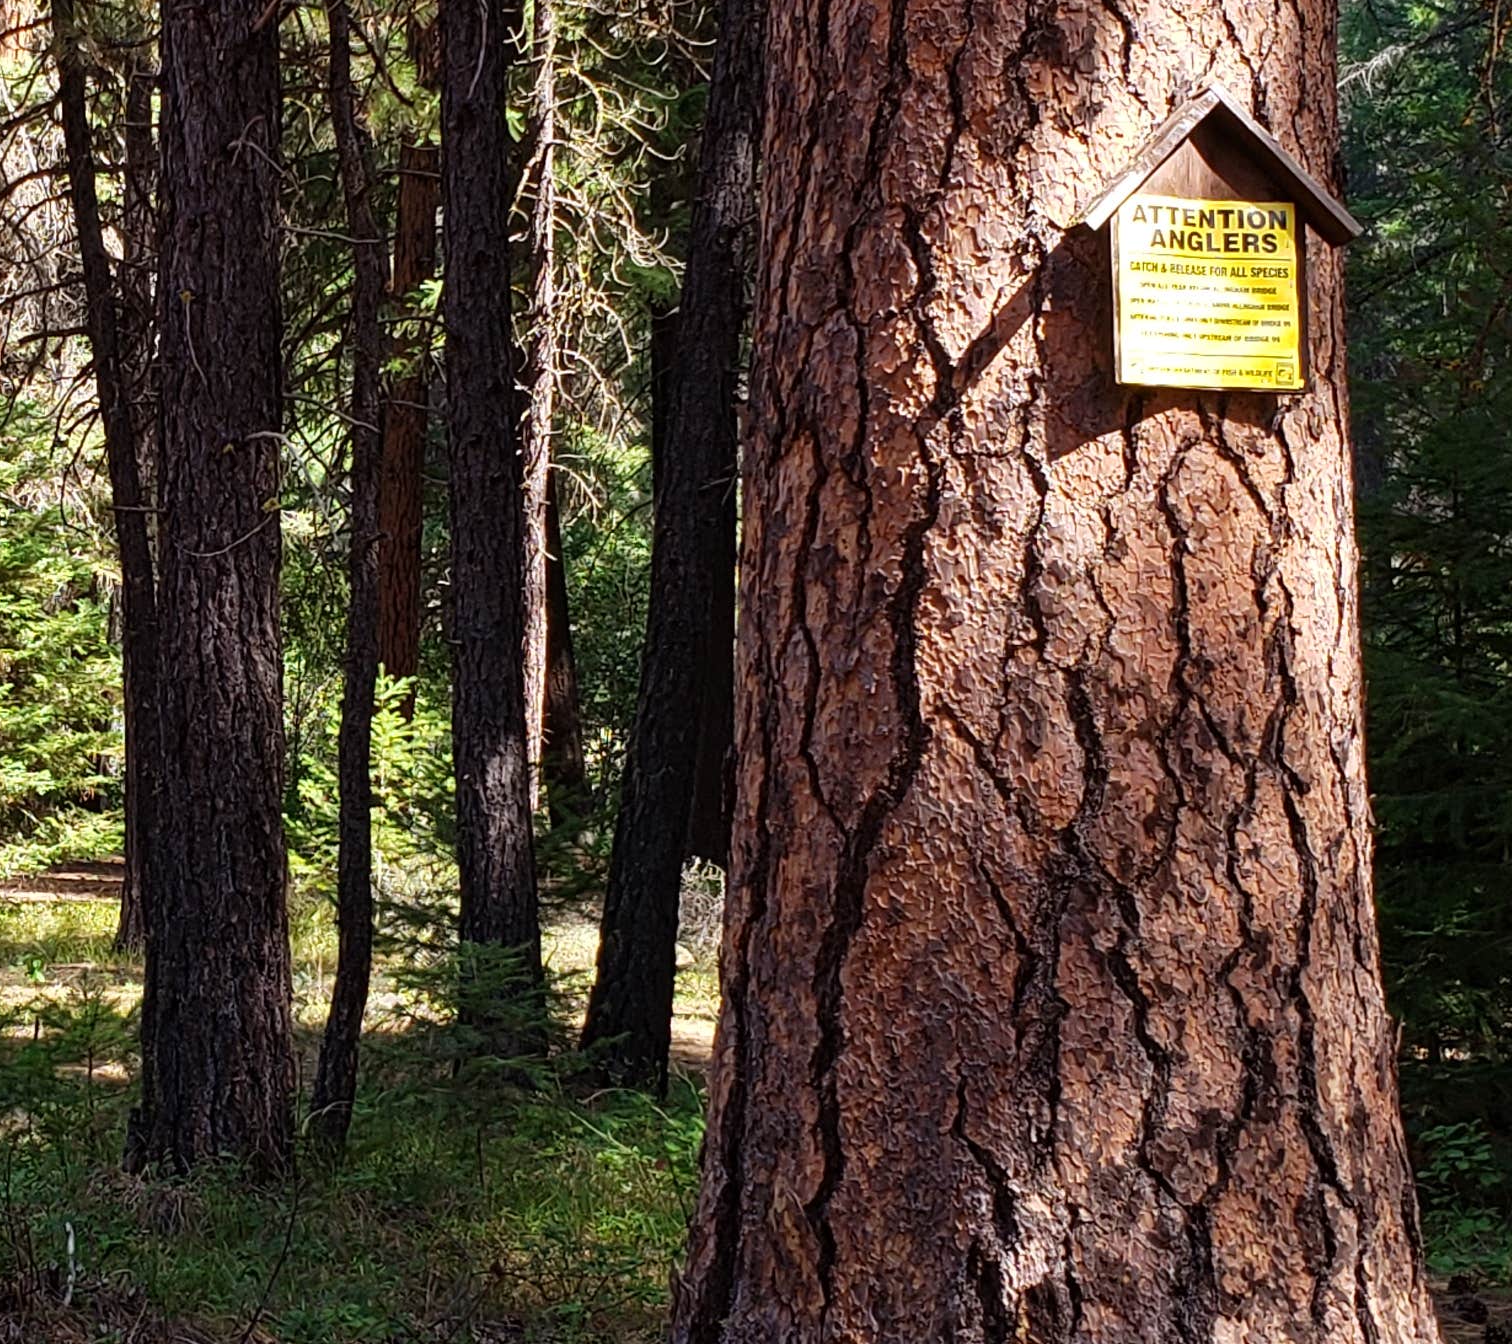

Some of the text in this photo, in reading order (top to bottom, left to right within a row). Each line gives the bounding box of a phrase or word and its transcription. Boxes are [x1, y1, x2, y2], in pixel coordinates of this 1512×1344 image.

[1133, 204, 1287, 231] ATTENTION
[1150, 229, 1278, 254] ANGLERS
[1130, 261, 1289, 279] CATCH & RELEASE FOR ALL SPECIES
